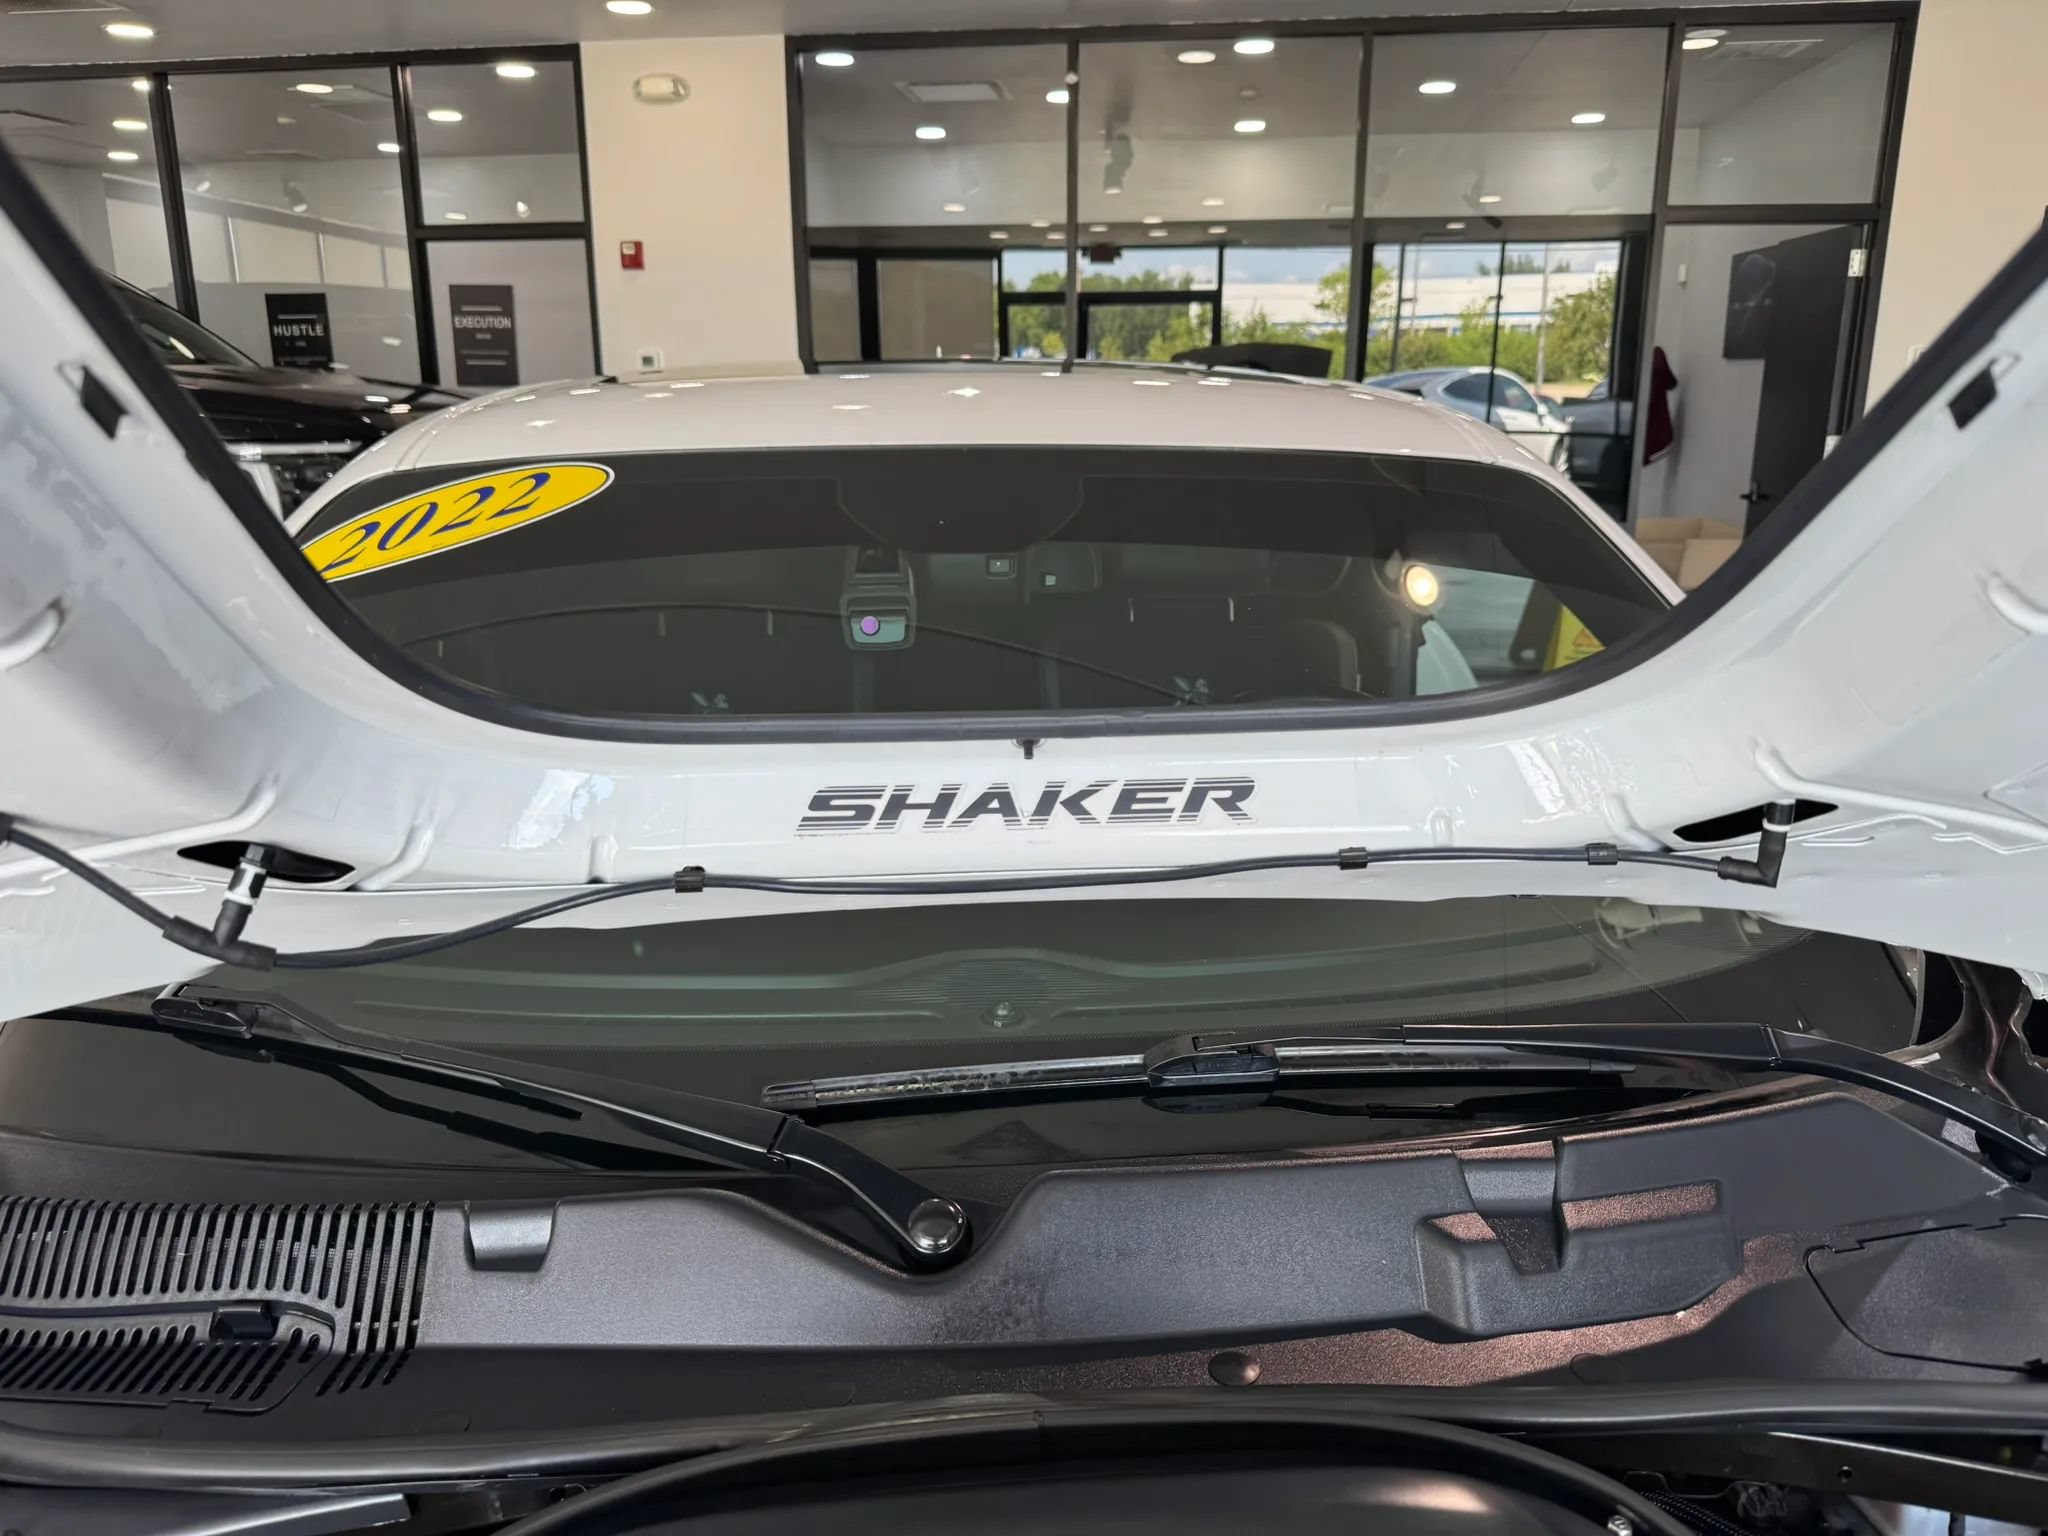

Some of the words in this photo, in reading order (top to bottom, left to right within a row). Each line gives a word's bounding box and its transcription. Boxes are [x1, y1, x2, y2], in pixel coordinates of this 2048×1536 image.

[273, 324, 325, 337] HUSTLE
[454, 315, 512, 329] EXECUTION
[319, 472, 551, 573] 2022
[795, 776, 1256, 832] SHAKER
